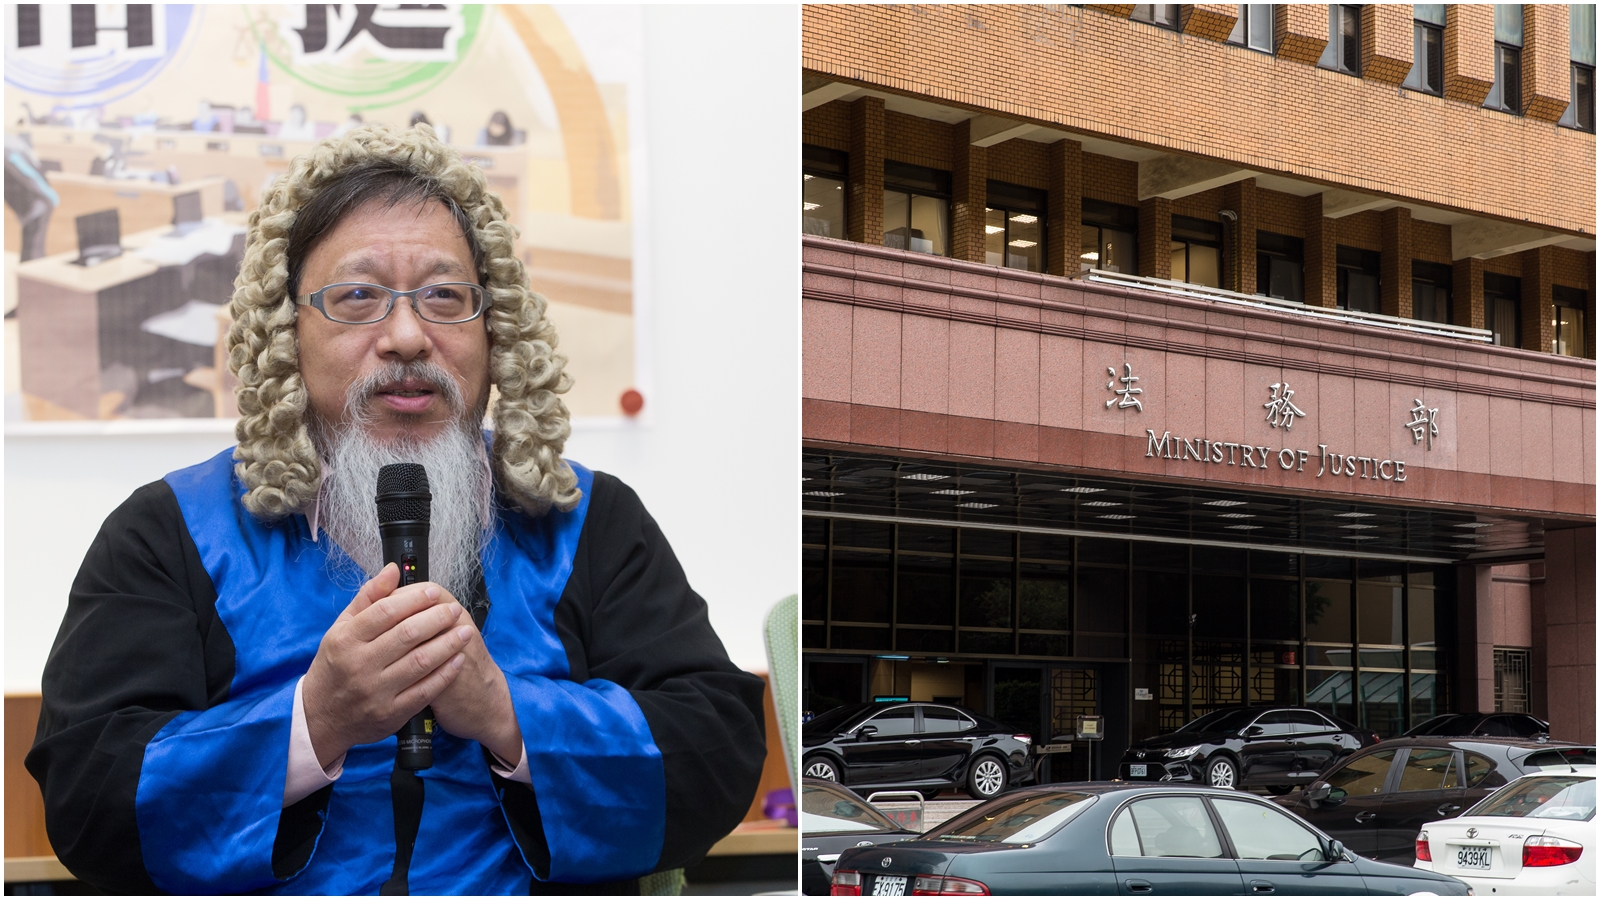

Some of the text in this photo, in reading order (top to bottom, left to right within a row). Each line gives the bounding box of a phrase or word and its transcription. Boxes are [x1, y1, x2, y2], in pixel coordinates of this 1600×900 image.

[1105, 362, 1439, 451] 法務部
[1145, 429, 1407, 482] MINISTRY OF JUSTICE
